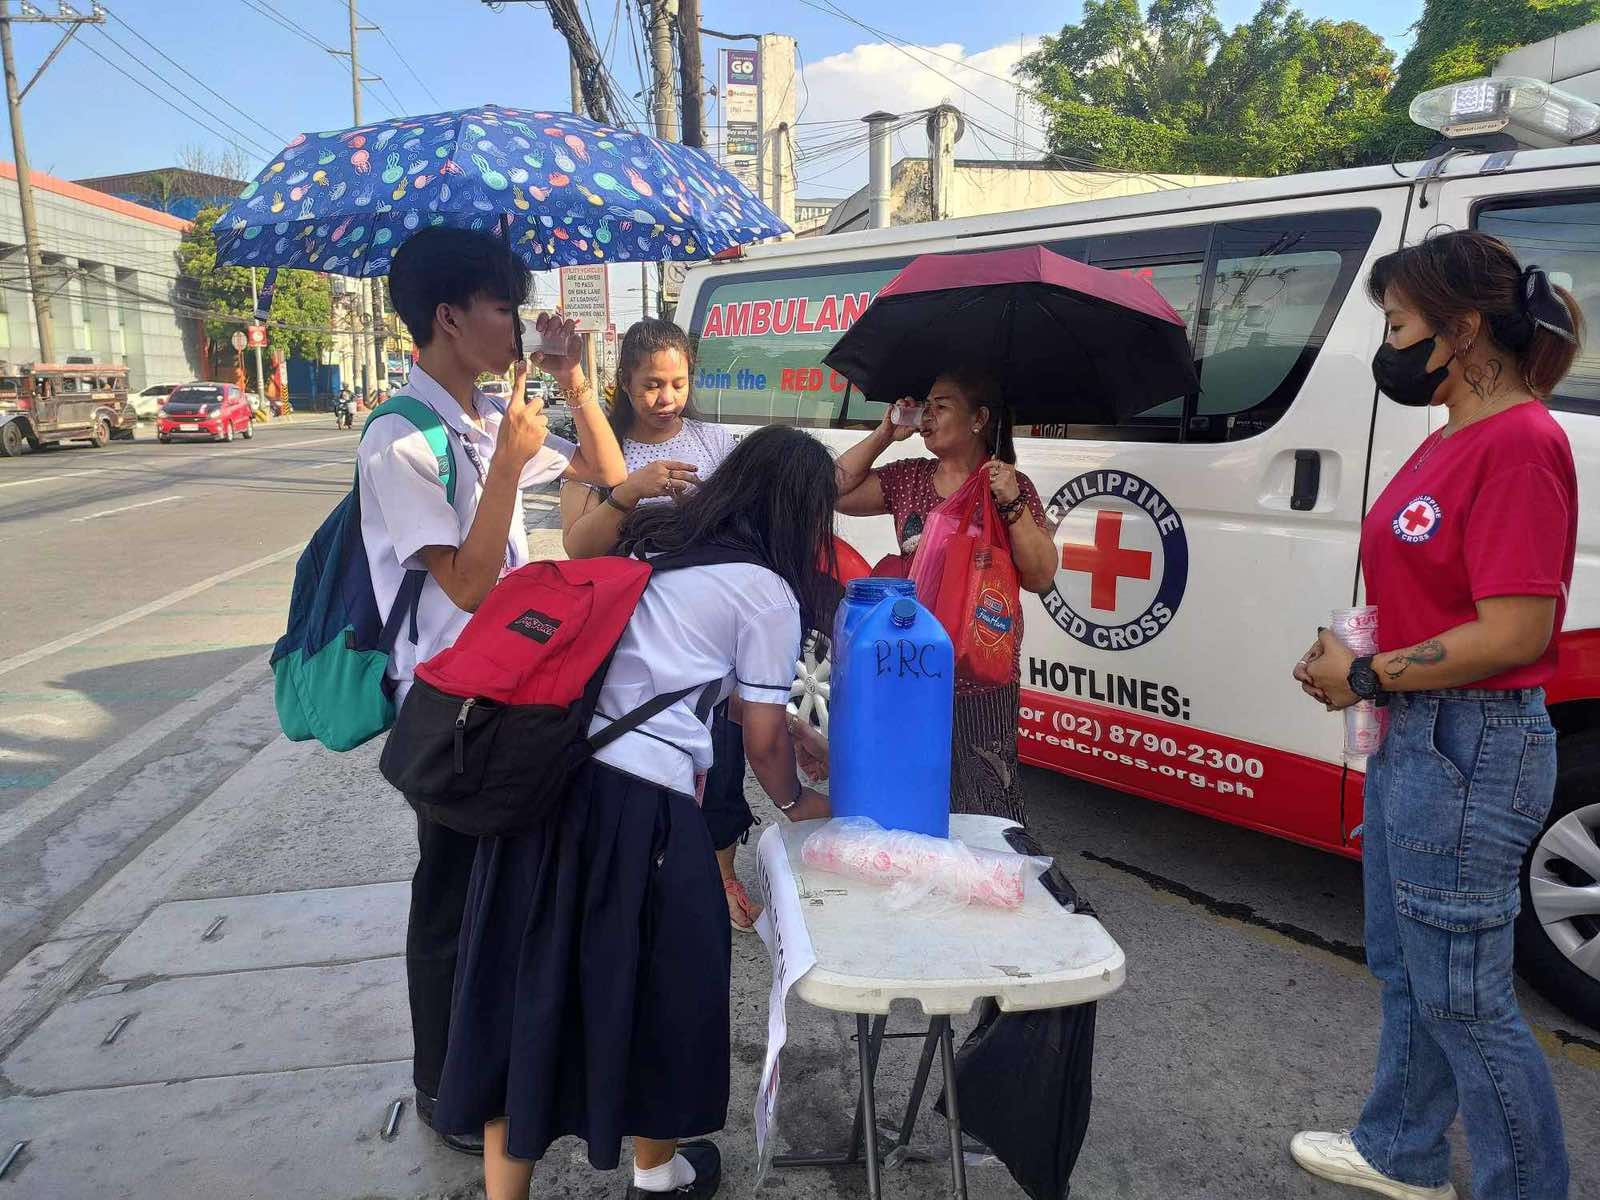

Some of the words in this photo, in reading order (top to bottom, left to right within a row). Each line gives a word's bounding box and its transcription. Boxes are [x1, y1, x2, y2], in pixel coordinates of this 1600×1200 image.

[731, 60, 754, 75] GO
[702, 291, 880, 339] AMBULAN
[694, 367, 732, 390] Join
[736, 367, 767, 390] the
[780, 368, 824, 392] RED
[1045, 473, 1180, 536] PHILIPPINE
[1401, 532, 1430, 543] CROSS
[1044, 590, 1087, 639] RED
[1092, 602, 1172, 649] CROSS
[1029, 656, 1191, 721] HOTLINES:
[1018, 706, 1046, 722] or
[1052, 711, 1102, 742] (02)
[1109, 724, 1265, 779] 8790-2300
